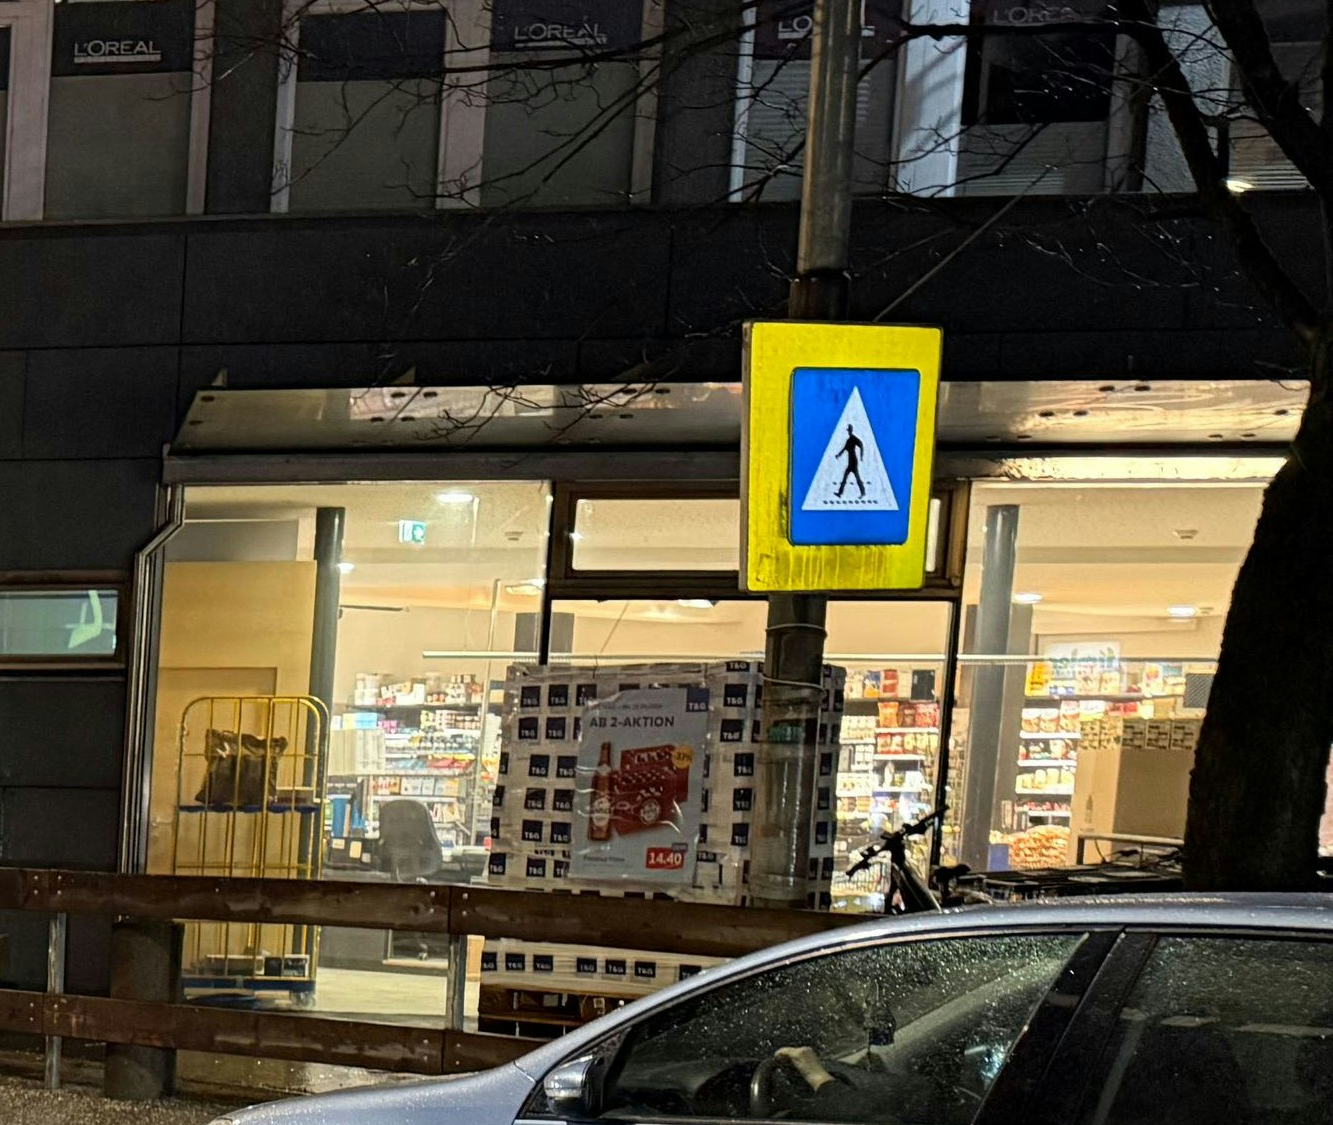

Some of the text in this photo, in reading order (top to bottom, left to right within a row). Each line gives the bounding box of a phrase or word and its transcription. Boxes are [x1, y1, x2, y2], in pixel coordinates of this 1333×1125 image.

[590, 716, 674, 728] AB 2-AKTION
[648, 852, 682, 866] 14.40
